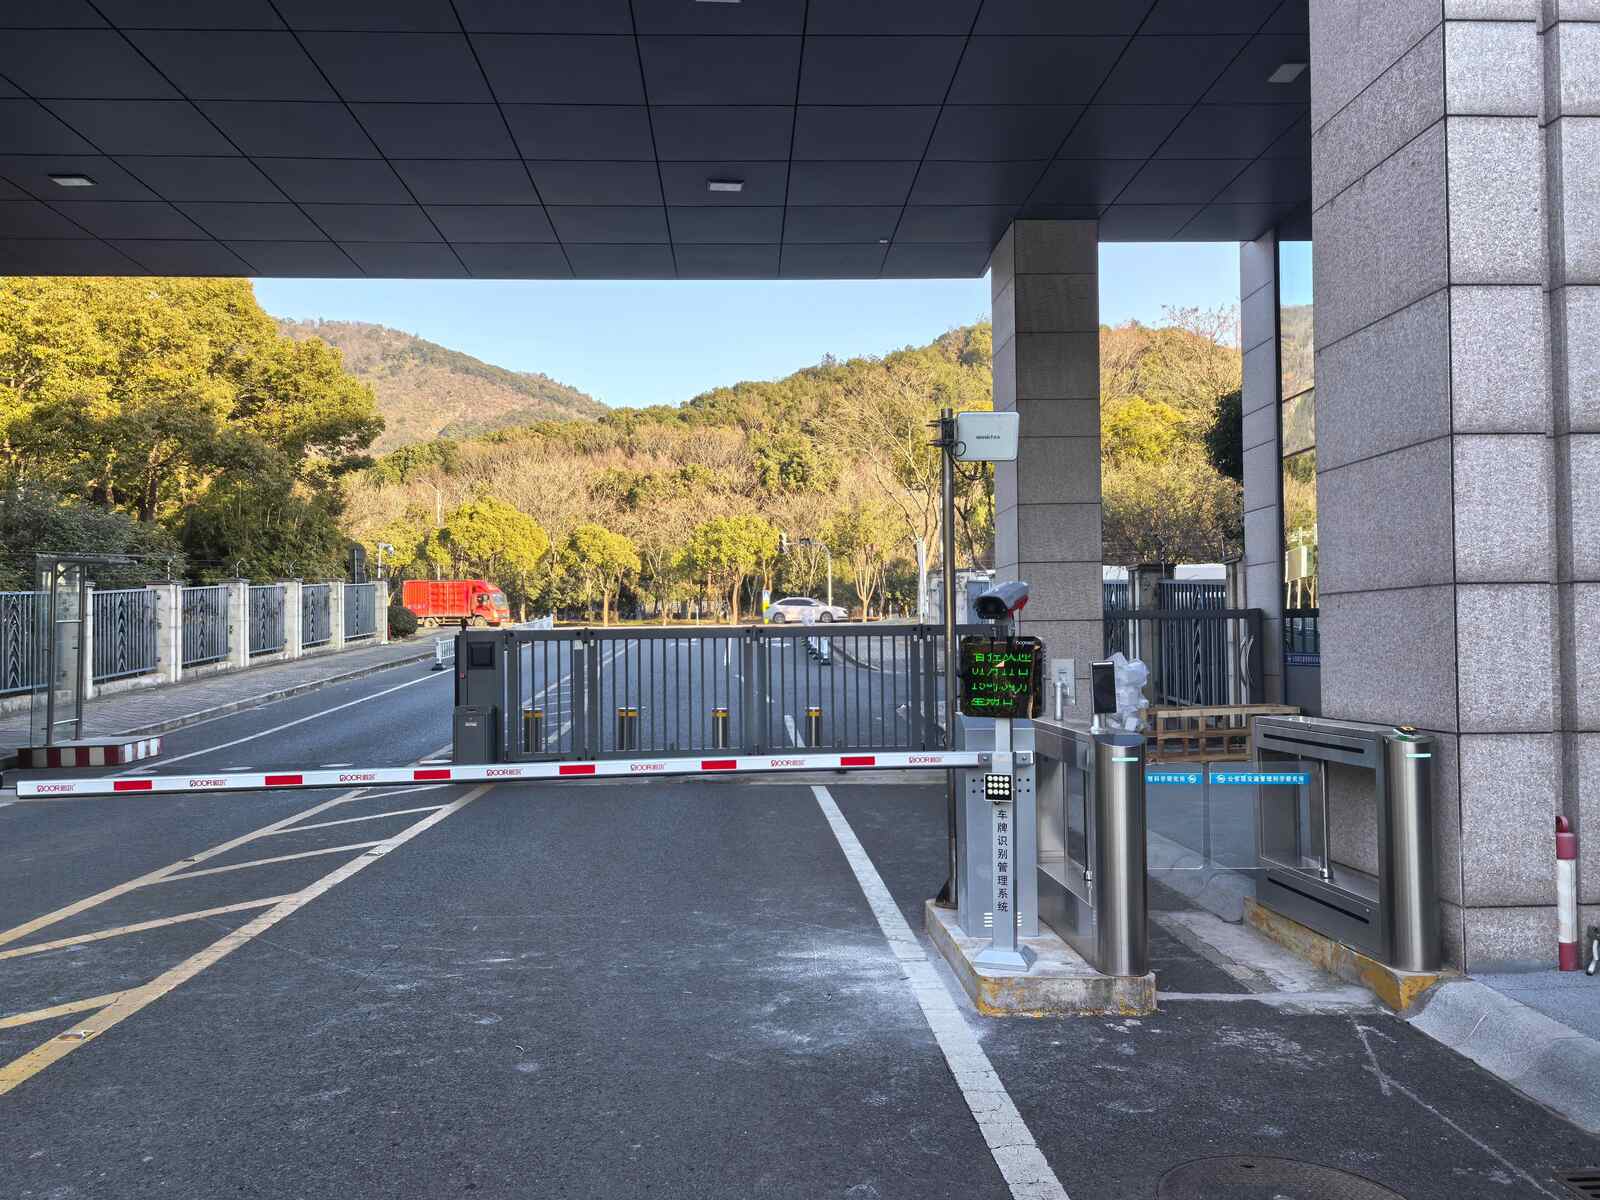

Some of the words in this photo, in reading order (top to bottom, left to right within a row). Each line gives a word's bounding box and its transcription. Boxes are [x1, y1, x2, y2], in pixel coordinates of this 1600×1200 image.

[996, 809, 1009, 913] 车牌识别管理系统
